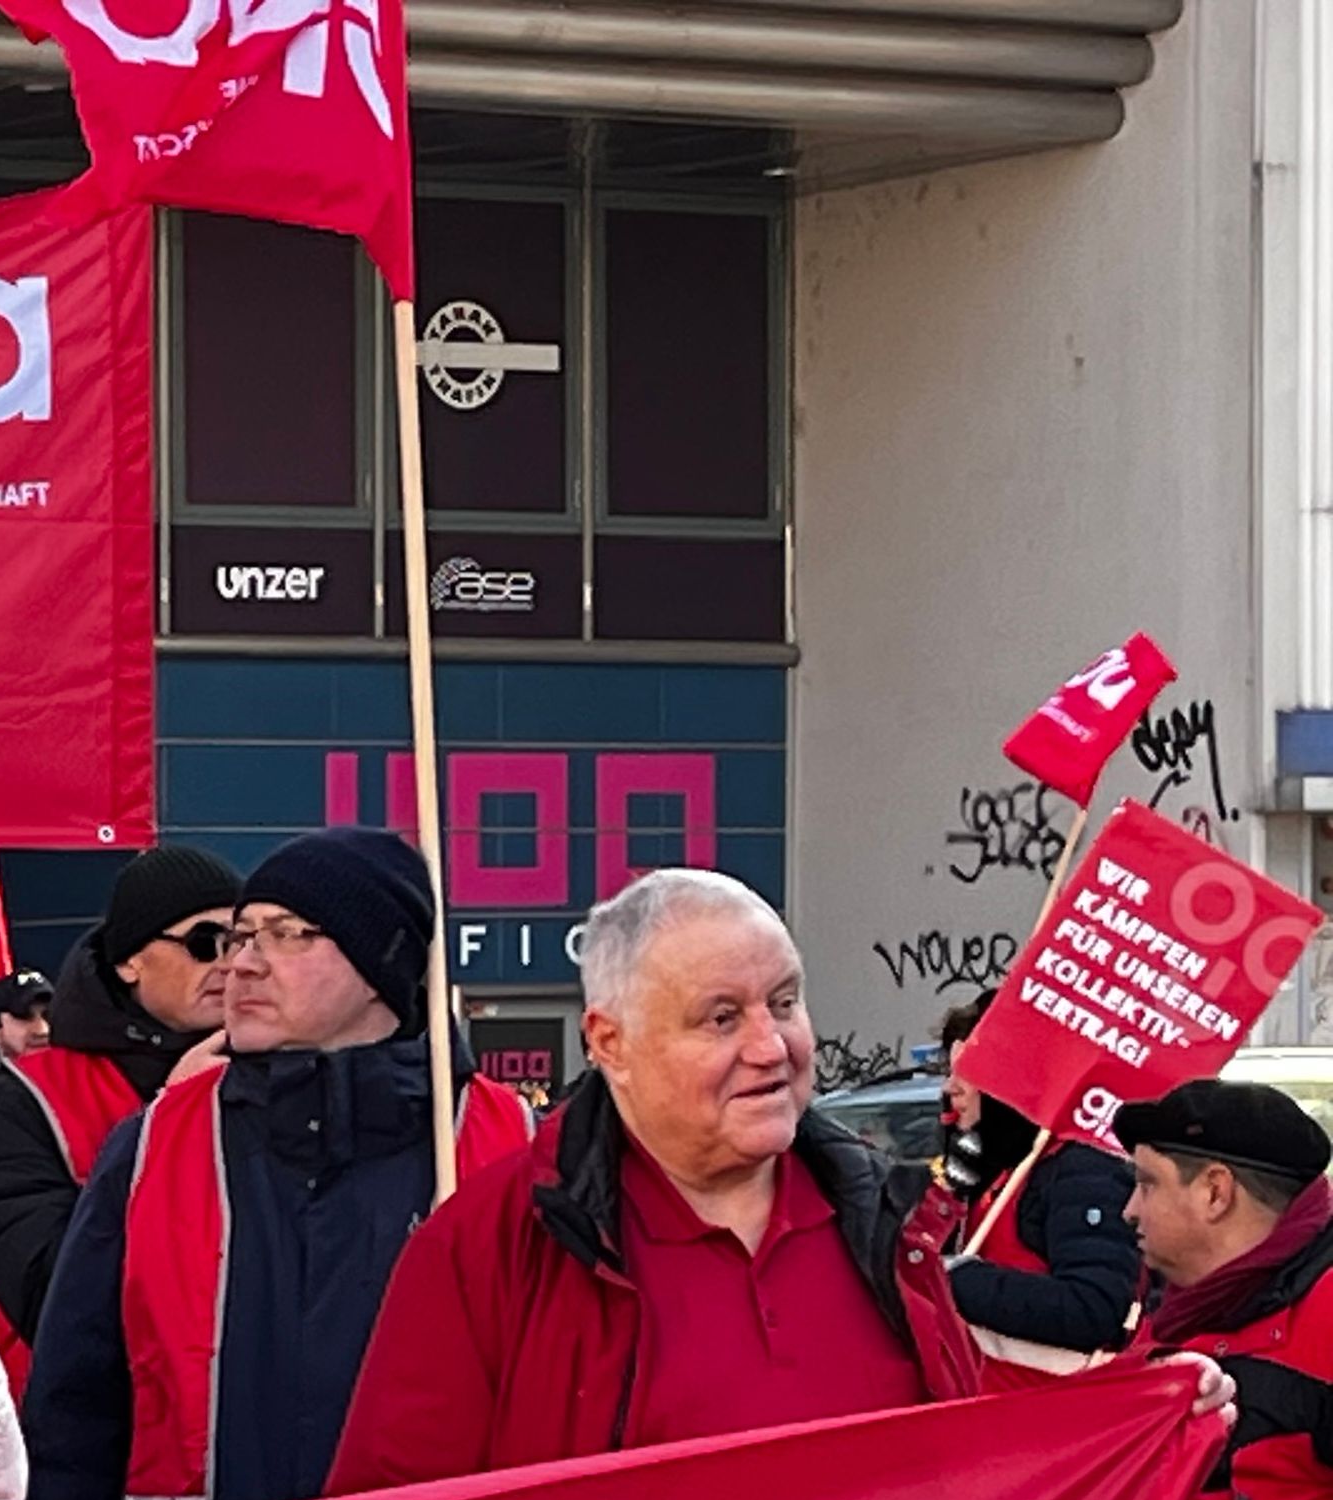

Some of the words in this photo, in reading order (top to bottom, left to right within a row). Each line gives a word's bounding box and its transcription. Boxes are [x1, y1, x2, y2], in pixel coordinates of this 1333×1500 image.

[217, 566, 325, 599] unzer
[1096, 856, 1151, 906] WIR
[1053, 917, 1113, 966] FÜR
[1113, 950, 1241, 1041] UNSEREN
[1072, 887, 1208, 981] KÄMPFEN
[1019, 975, 1151, 1069] VERTRAG!
[1034, 946, 1191, 1049] KOLLEKTIV-
